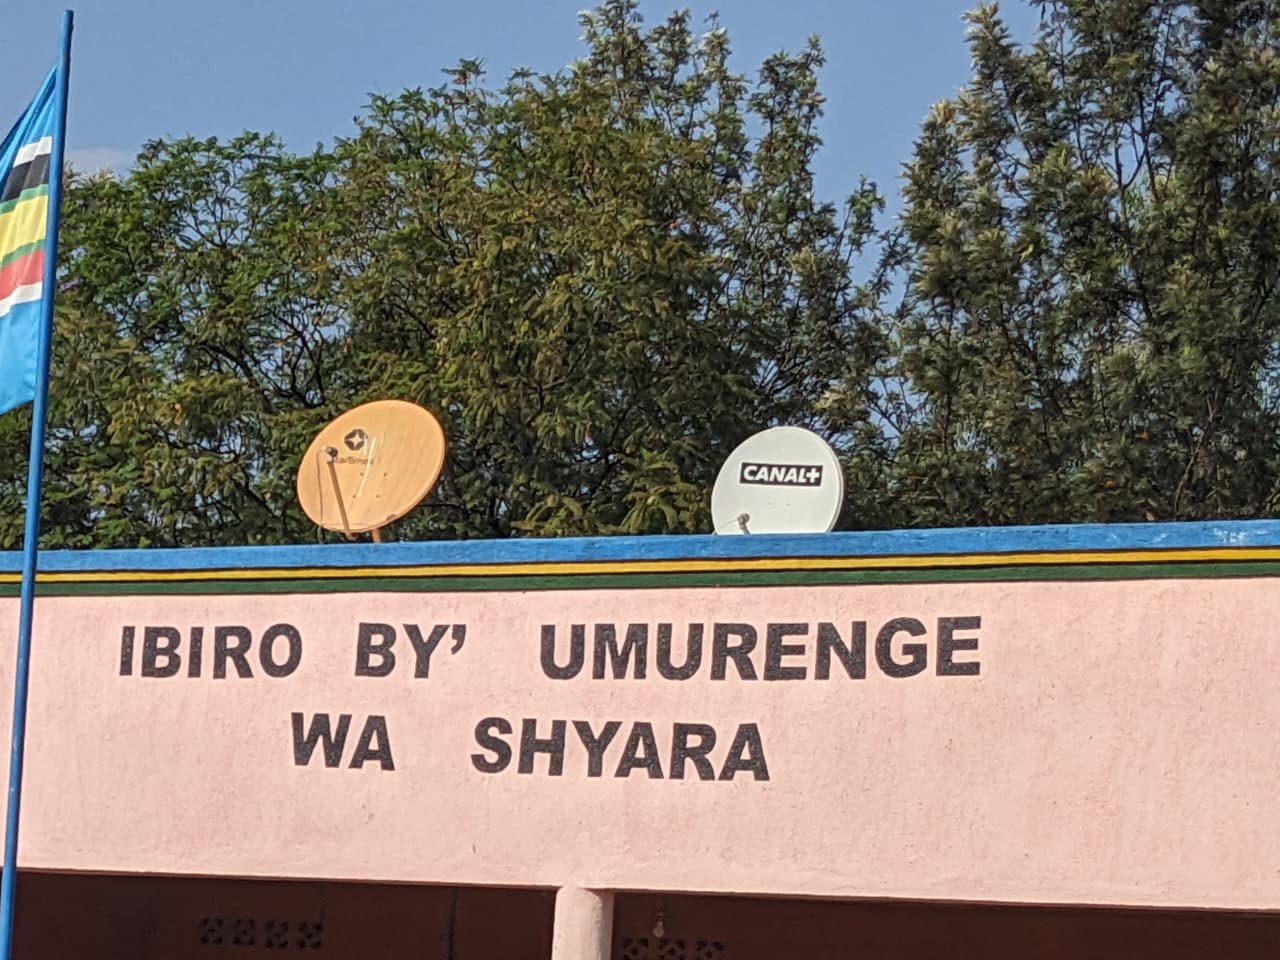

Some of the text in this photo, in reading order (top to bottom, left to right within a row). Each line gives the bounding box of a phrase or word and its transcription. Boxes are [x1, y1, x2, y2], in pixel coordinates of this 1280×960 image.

[743, 465, 820, 483] CANAL+
[119, 623, 303, 679] IBIRO
[540, 615, 982, 682] UMURENGE
[291, 712, 770, 781] WA SHYARA
